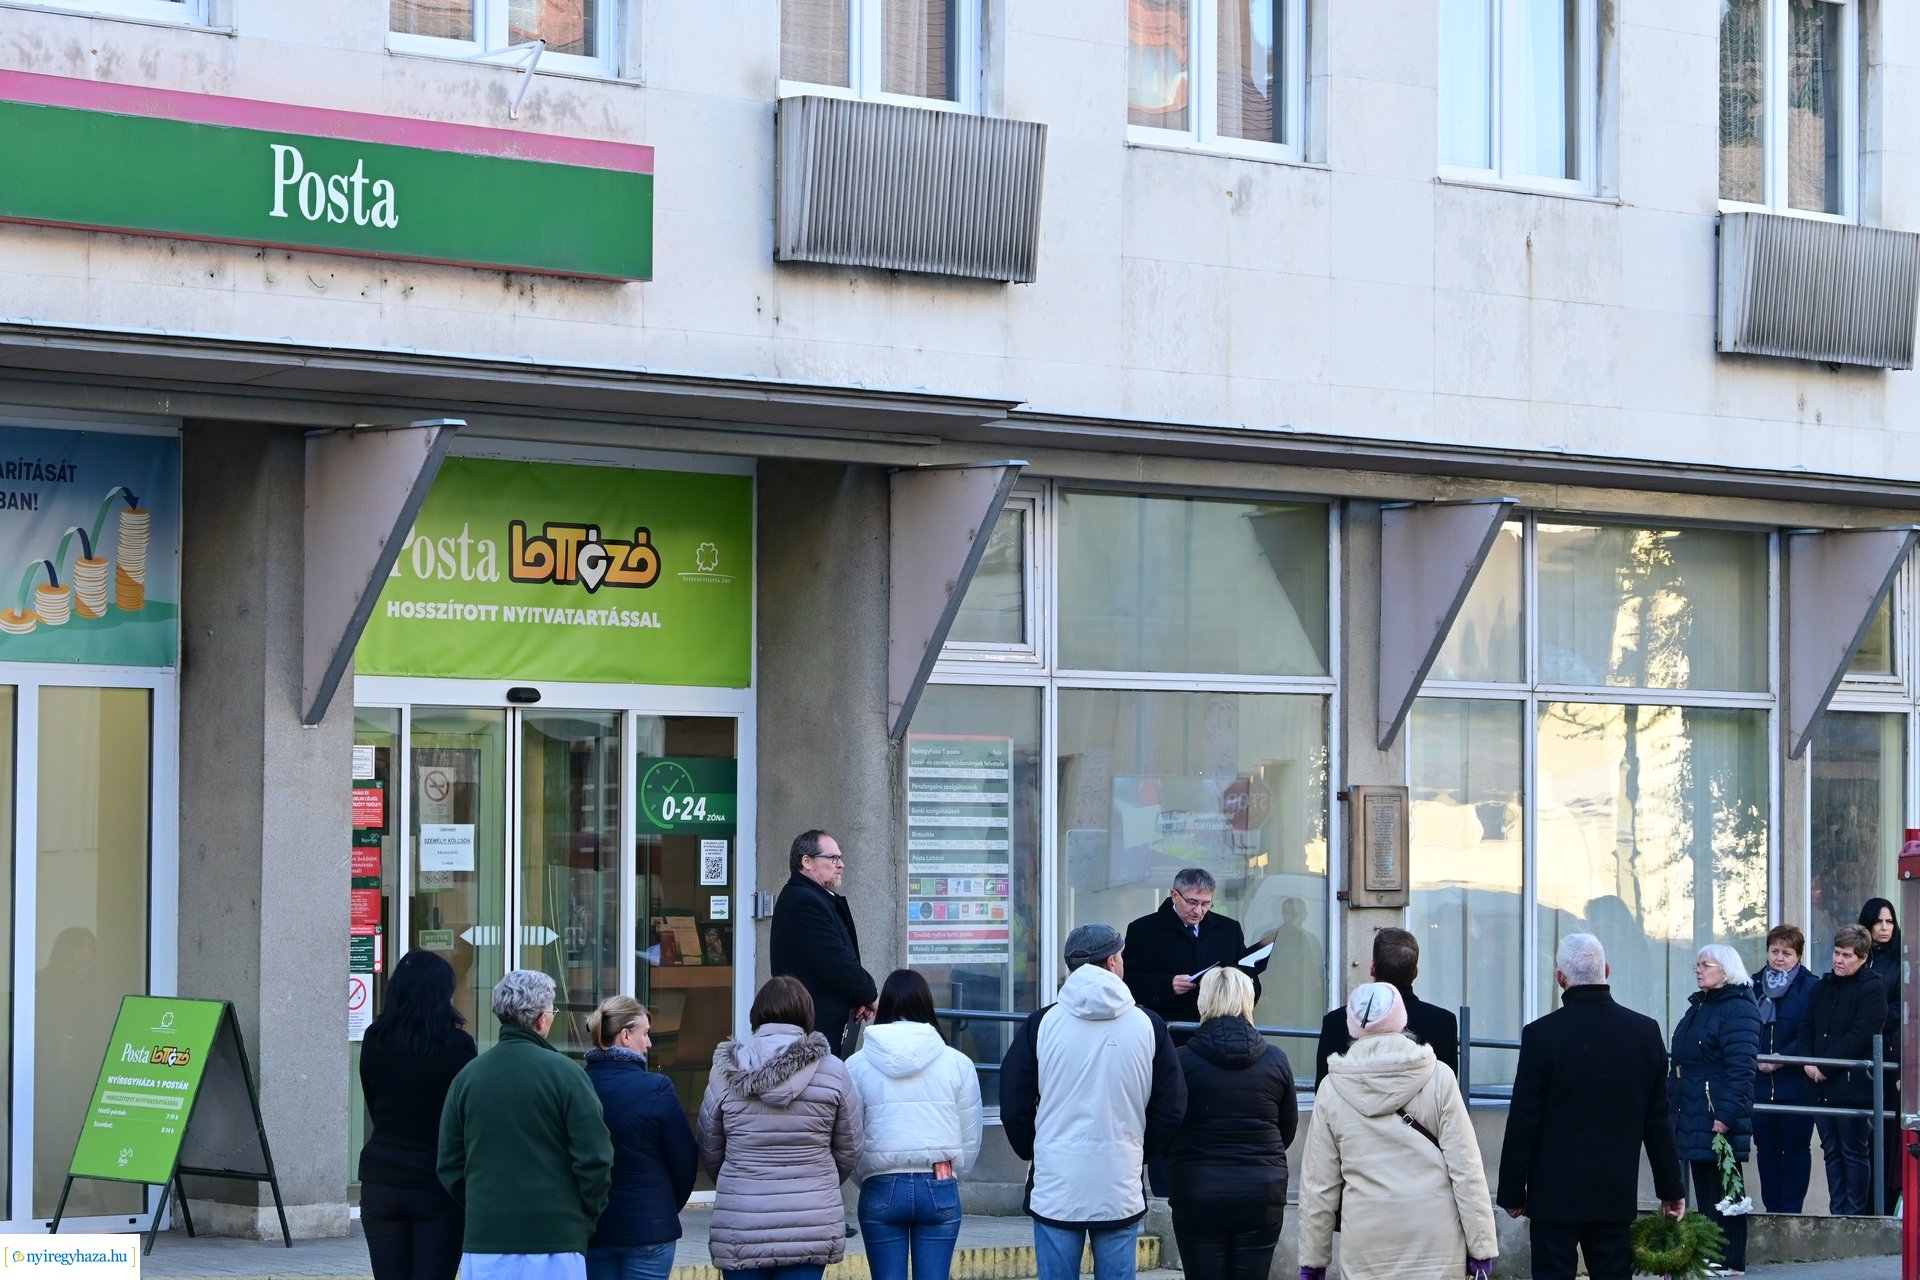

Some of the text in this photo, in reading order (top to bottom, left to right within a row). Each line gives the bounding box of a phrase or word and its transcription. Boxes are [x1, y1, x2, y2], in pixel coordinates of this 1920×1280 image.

[269, 144, 399, 229] Posta
[387, 600, 661, 628] HOSSZÍTOTT NYITVATARTÁSSAL
[662, 796, 725, 821] 0-24 ZÓNA
[120, 1043, 149, 1063] Posta
[107, 1075, 154, 1087] NYÍREGYHÁZA
[162, 1080, 189, 1090] POSTÁN
[105, 1094, 179, 1106] HOSSZÍTOTT NYITVATARTÁSSAL
